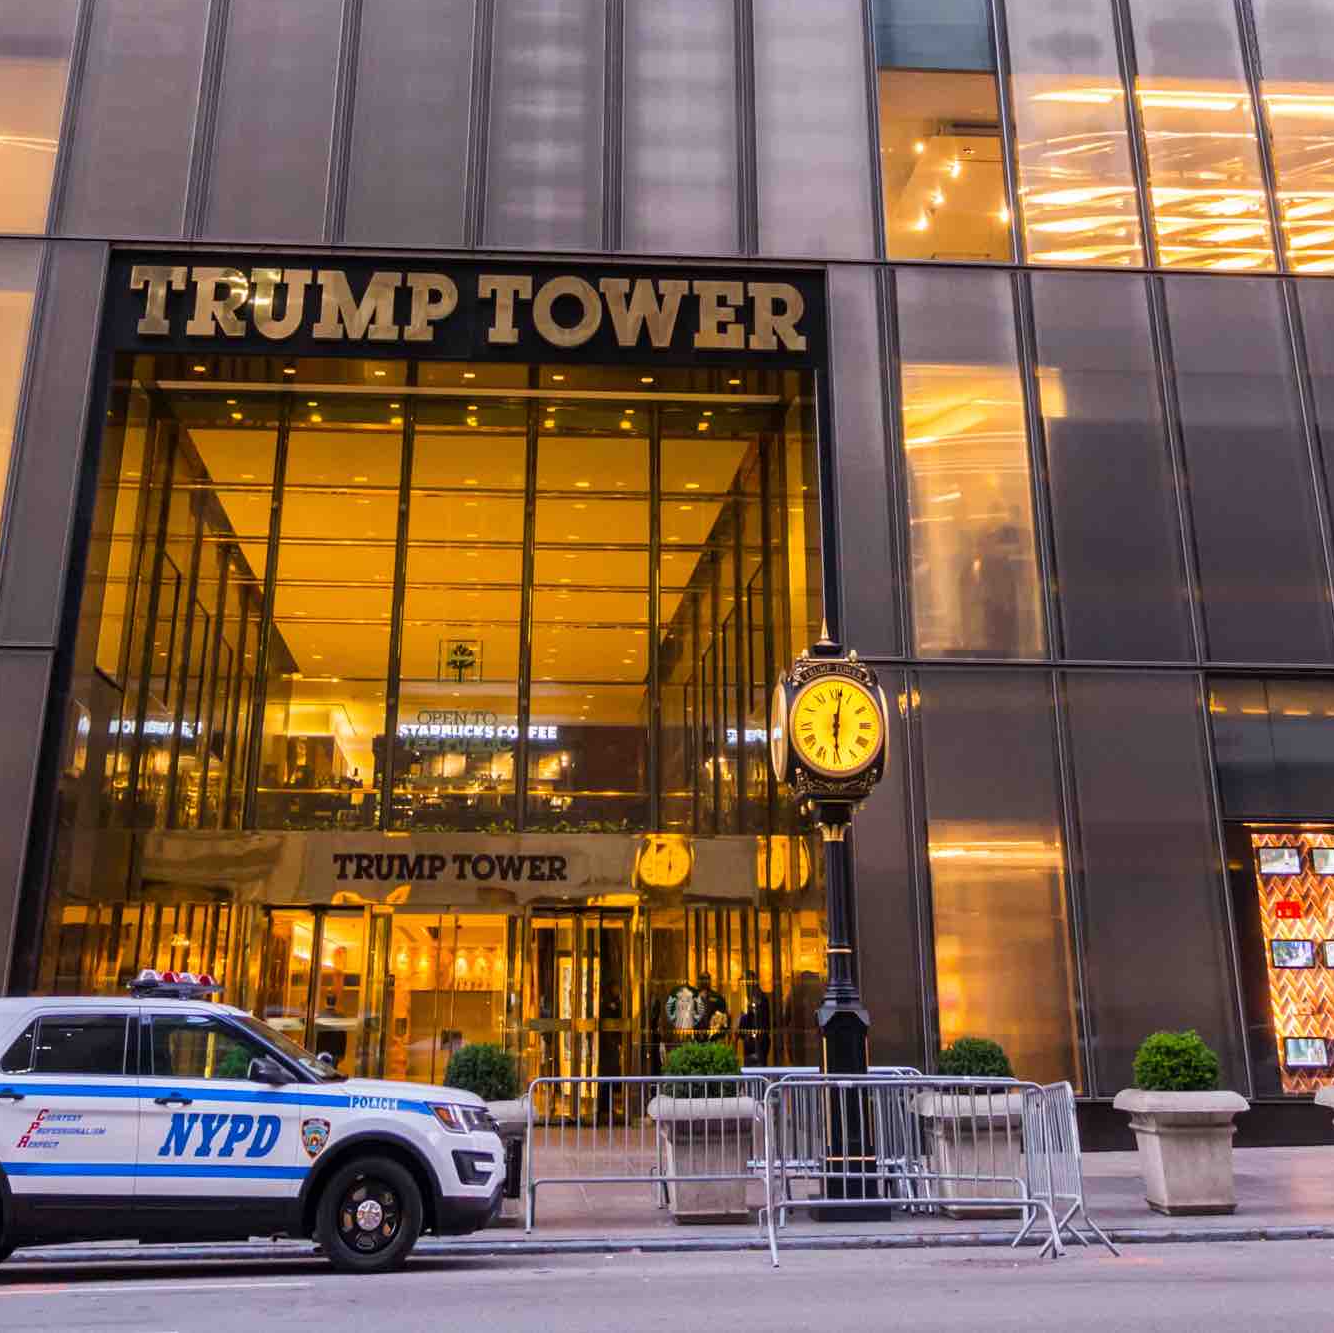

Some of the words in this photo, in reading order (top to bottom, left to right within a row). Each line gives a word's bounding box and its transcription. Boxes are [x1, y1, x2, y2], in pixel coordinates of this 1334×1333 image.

[130, 265, 459, 344] TRUMP
[477, 273, 809, 353] TOWER
[417, 710, 466, 725] OPEN
[467, 710, 498, 725] TO
[398, 723, 495, 739] STARBUCKS
[497, 724, 558, 740] COFEE
[332, 853, 447, 881] TRUMP
[453, 853, 568, 881] TOWER
[351, 1096, 397, 1110] POLICE
[158, 1113, 282, 1158] NYPD
